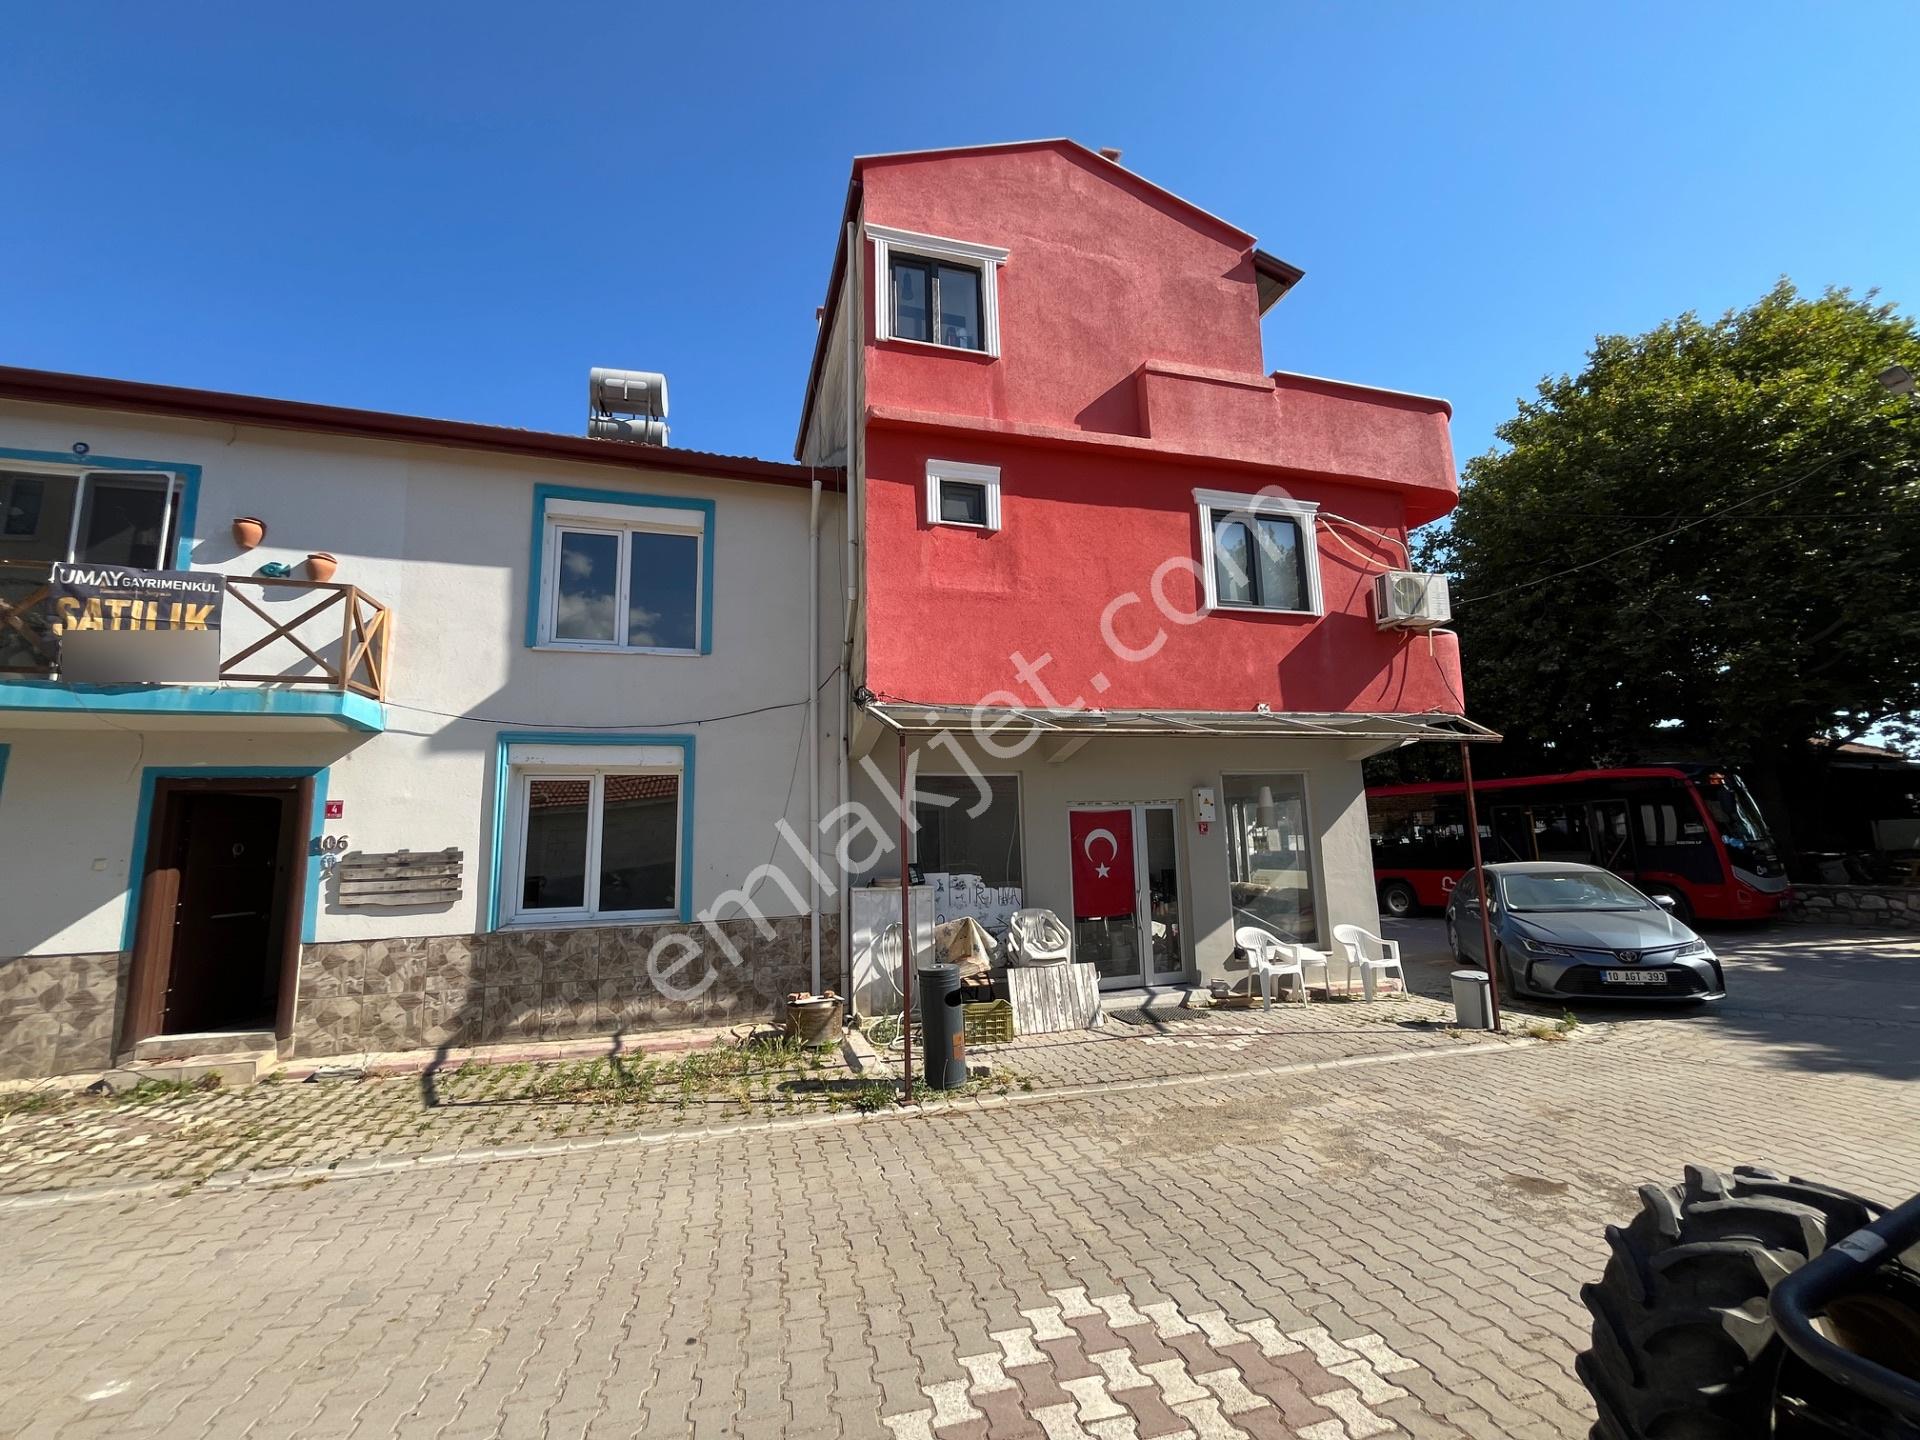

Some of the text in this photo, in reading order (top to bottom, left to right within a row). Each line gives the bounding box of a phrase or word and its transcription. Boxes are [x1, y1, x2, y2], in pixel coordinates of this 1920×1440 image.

[60, 568, 124, 588] UMAY
[1608, 972, 1665, 982] 10 AGT 393
